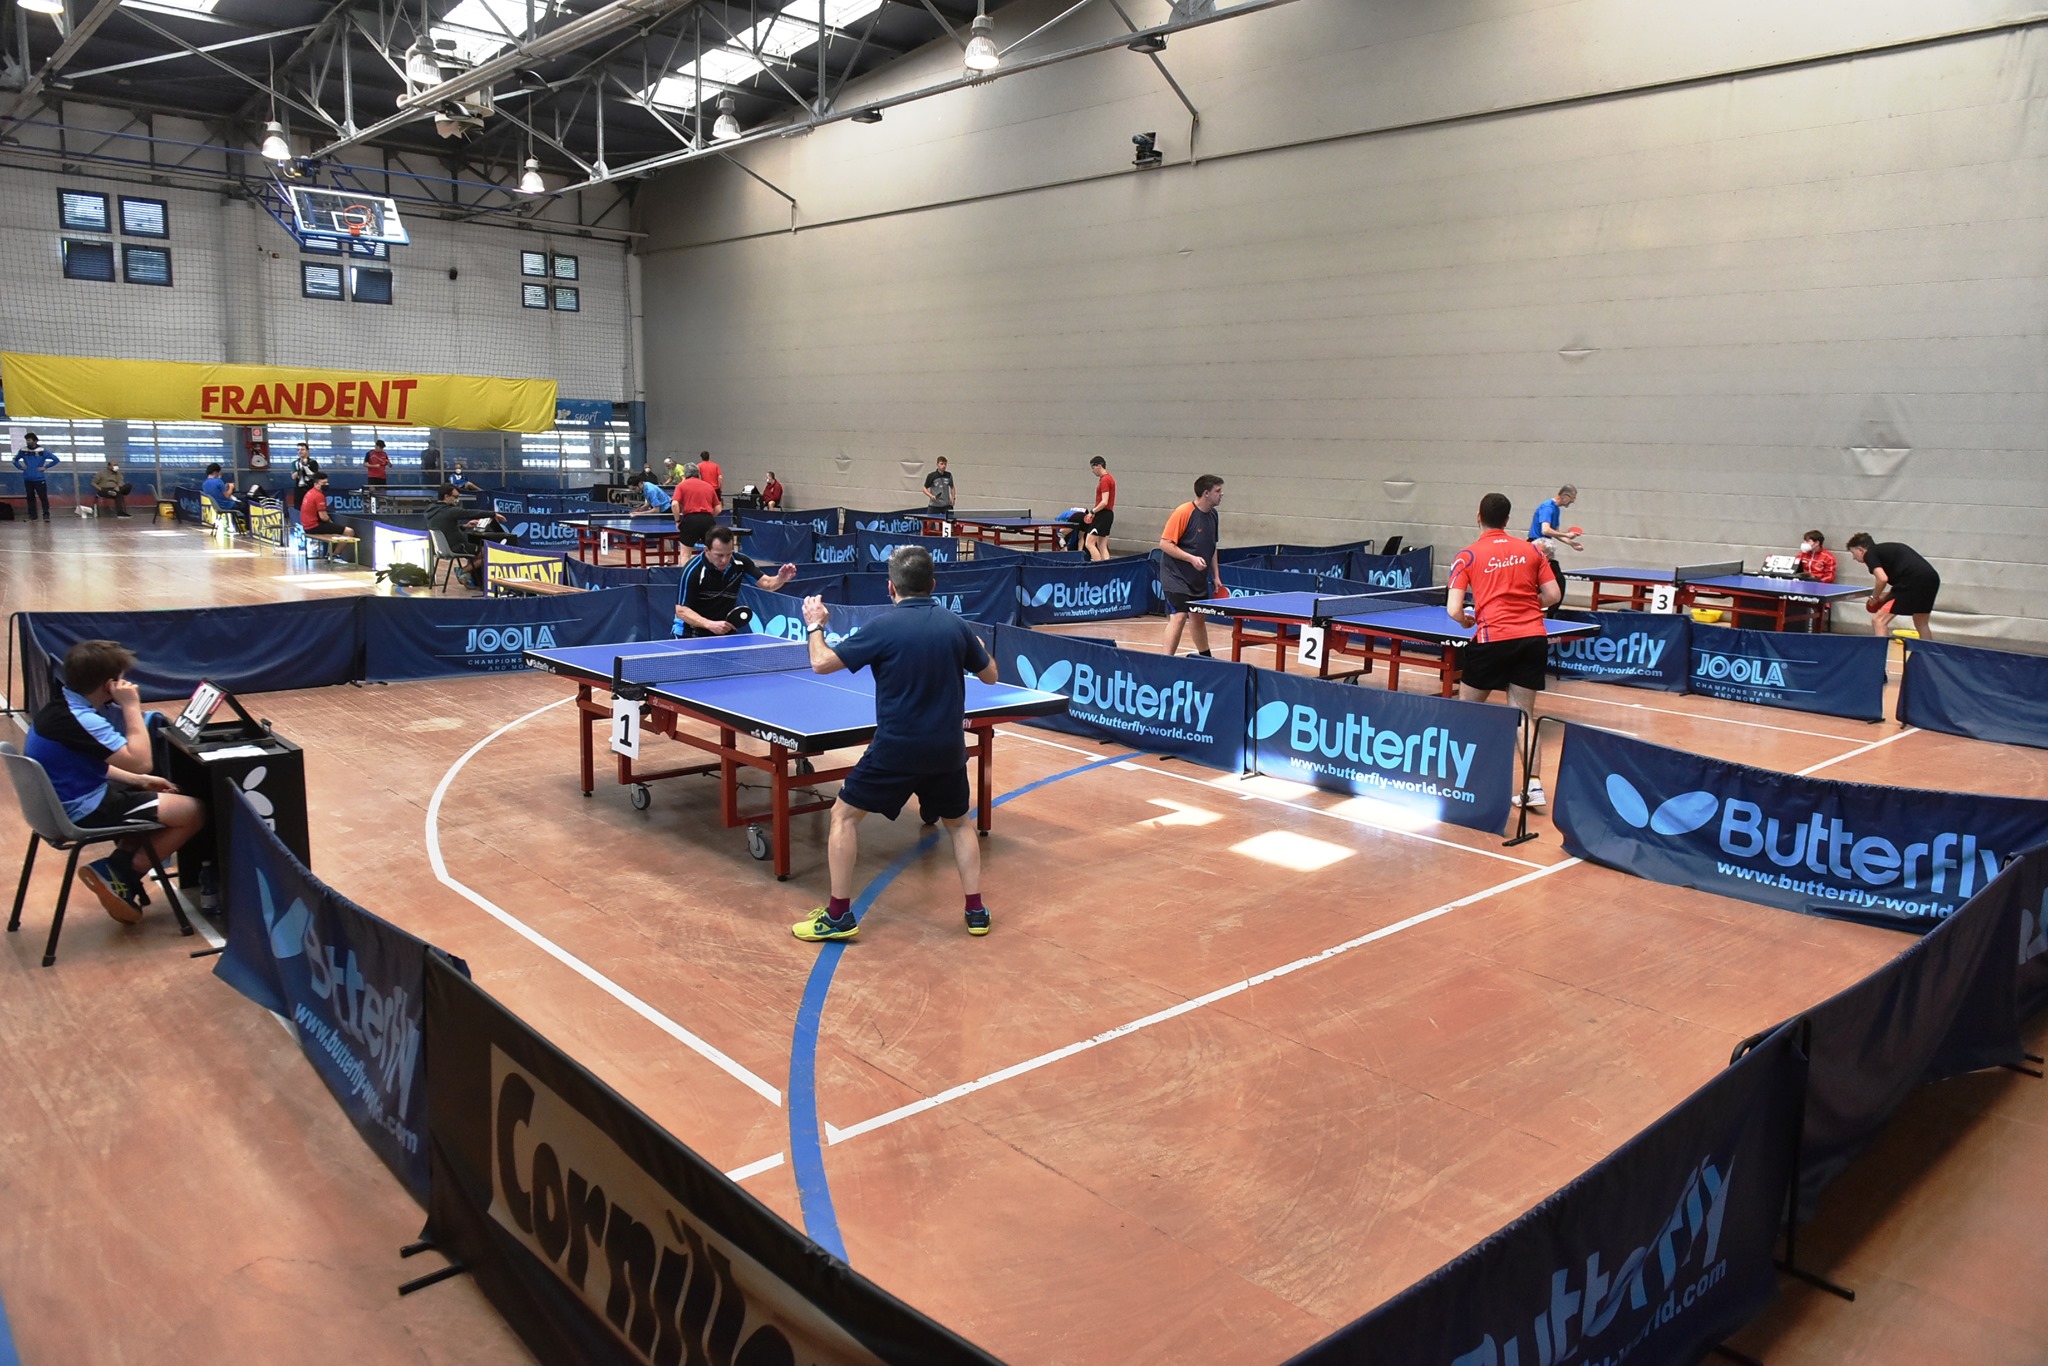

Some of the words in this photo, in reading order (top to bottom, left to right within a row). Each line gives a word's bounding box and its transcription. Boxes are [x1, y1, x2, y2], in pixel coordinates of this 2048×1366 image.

[201, 380, 417, 419] FRANDENT
[944, 527, 949, 537] 5
[1484, 555, 1526, 574] Sicilia
[1054, 578, 1131, 608] Butterfly
[1656, 594, 1668, 610] 3
[1053, 604, 1132, 617] www.butterfly-world.com
[465, 625, 557, 653] JOOLA
[1304, 637, 1318, 661] 2
[467, 658, 523, 666] CHAMPIONS
[1696, 653, 1786, 688] JOOLA
[1073, 663, 1214, 732] Butterfly
[1695, 682, 1748, 696] CHAMPIONS
[1752, 690, 1783, 700] TABLE
[1714, 692, 1732, 700] AND
[1735, 695, 1761, 704] MORE
[619, 713, 633, 748] 1
[1068, 708, 1214, 744] www.butterfly-world.com
[772, 732, 799, 751] Butterfly
[1291, 704, 1477, 789] Butterfly
[1290, 756, 1475, 804] www.butterfly-world.com
[1717, 861, 1954, 919] www.butterfly-world
